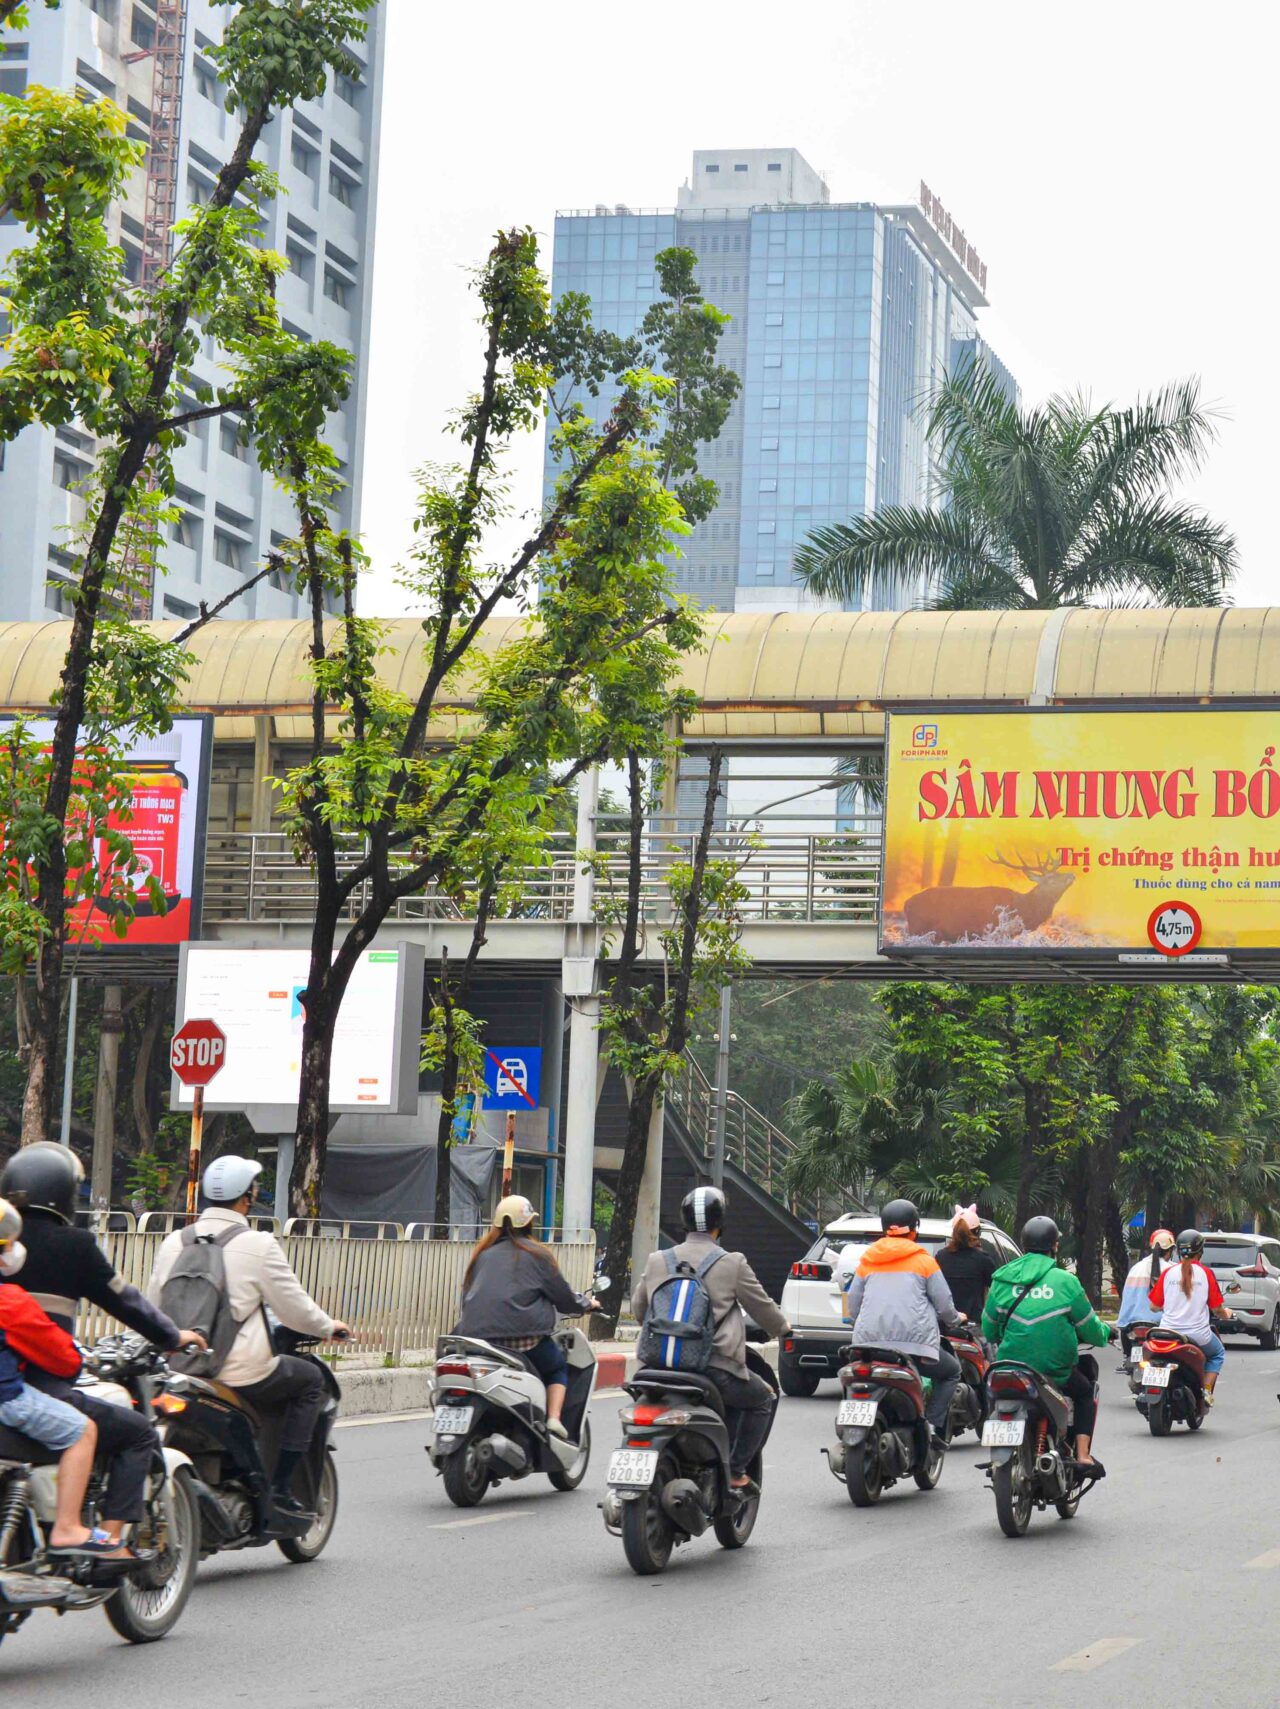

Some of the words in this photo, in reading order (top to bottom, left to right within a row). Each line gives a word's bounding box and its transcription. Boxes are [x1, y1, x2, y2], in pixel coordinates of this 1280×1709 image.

[918, 758, 1020, 822] SÂM
[1029, 767, 1200, 820] NHUNG
[157, 813, 174, 824] TW3
[1056, 846, 1090, 873] Trị
[1098, 845, 1174, 872] chứng
[1181, 845, 1240, 874] thận
[1133, 875, 1171, 889] Thuốc
[1175, 877, 1207, 891] dùng
[1210, 878, 1233, 889] cho
[1237, 877, 1250, 889] cả
[1254, 880, 1280, 889] nam
[173, 1038, 223, 1067] STOP
[616, 1452, 649, 1467] 29-P1
[609, 1467, 651, 1482] 820.93
